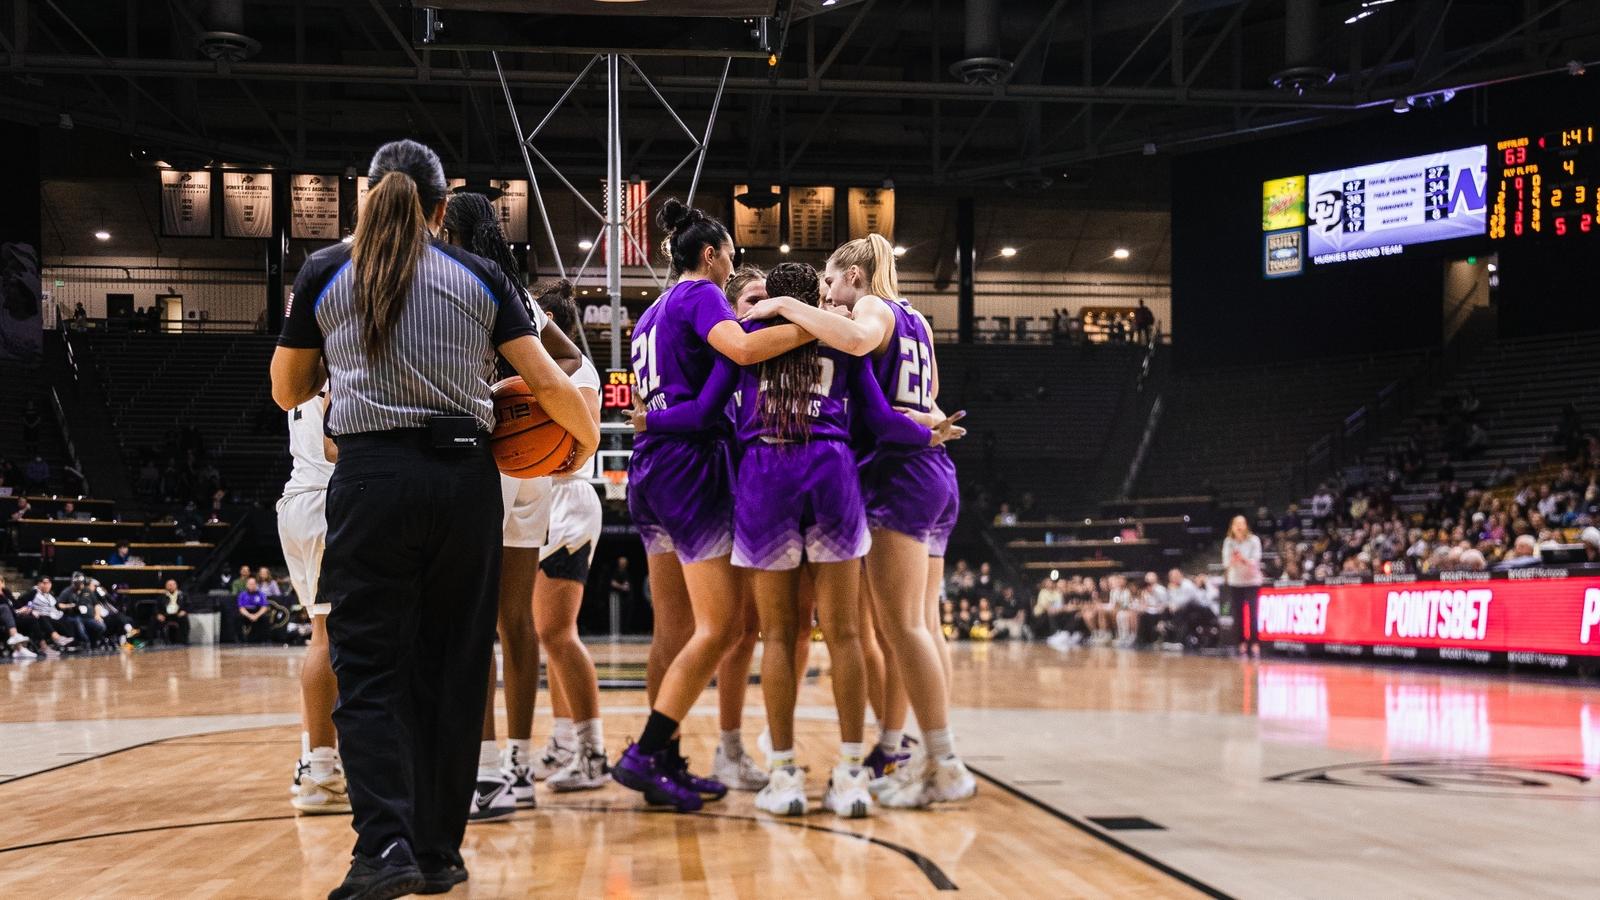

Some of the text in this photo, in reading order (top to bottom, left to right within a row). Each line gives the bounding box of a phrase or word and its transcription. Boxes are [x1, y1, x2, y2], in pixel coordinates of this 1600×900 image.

[1562, 127, 1593, 147] 1:41
[1505, 147, 1526, 164] 63
[1428, 167, 1444, 179] 27
[1563, 160, 1574, 175] 4
[1346, 181, 1361, 192] 47
[1429, 181, 1444, 192] 34
[1551, 186, 1586, 207] 2 3
[1431, 195, 1443, 206] 11
[1348, 219, 1361, 232] 17
[1555, 213, 1592, 235] 5 2
[1314, 244, 1403, 264] HUSKIES SECOND TEAM
[631, 325, 660, 399] 21
[896, 337, 932, 409] 22
[604, 385, 630, 407] 30
[1258, 593, 1330, 634] POINTSBET
[1385, 589, 1493, 640] POINTSBET
